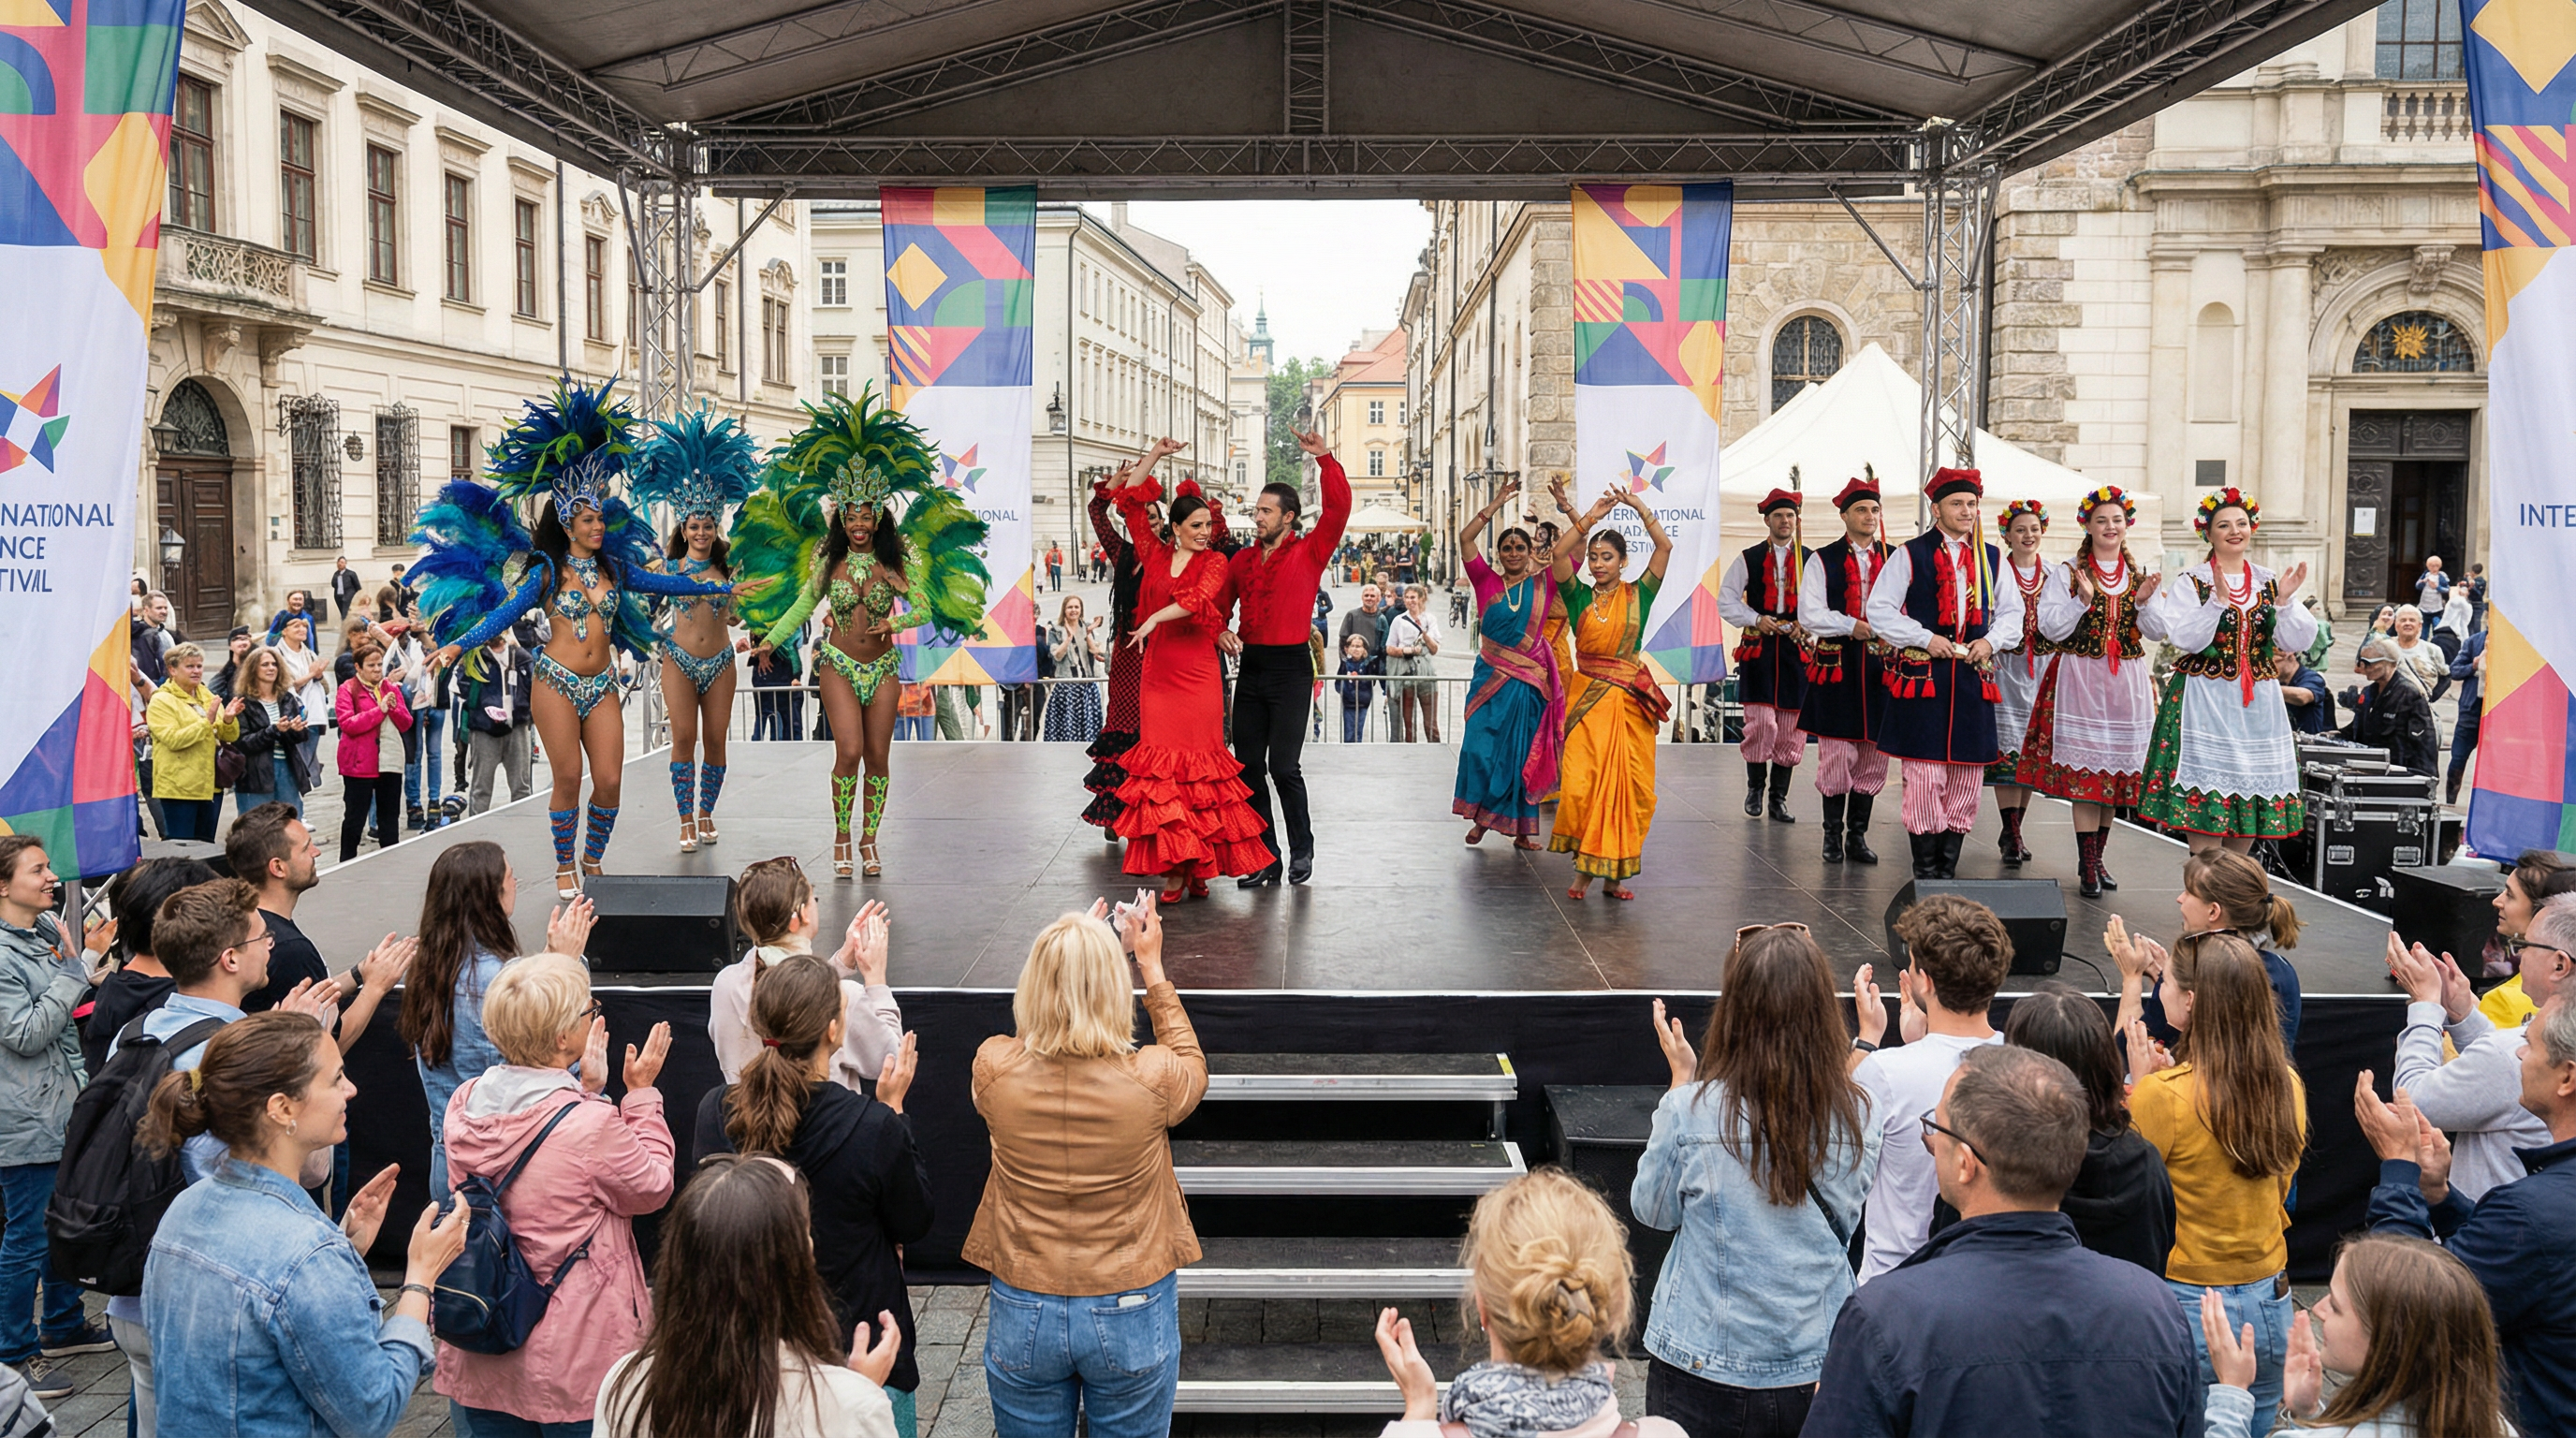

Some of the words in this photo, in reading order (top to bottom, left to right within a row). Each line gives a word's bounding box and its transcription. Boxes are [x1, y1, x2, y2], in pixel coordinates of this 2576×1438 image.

[1, 503, 114, 527] NATIONAL
[972, 509, 1018, 521] IONAL
[2520, 503, 2576, 528] INTE
[0, 536, 46, 559] NCE
